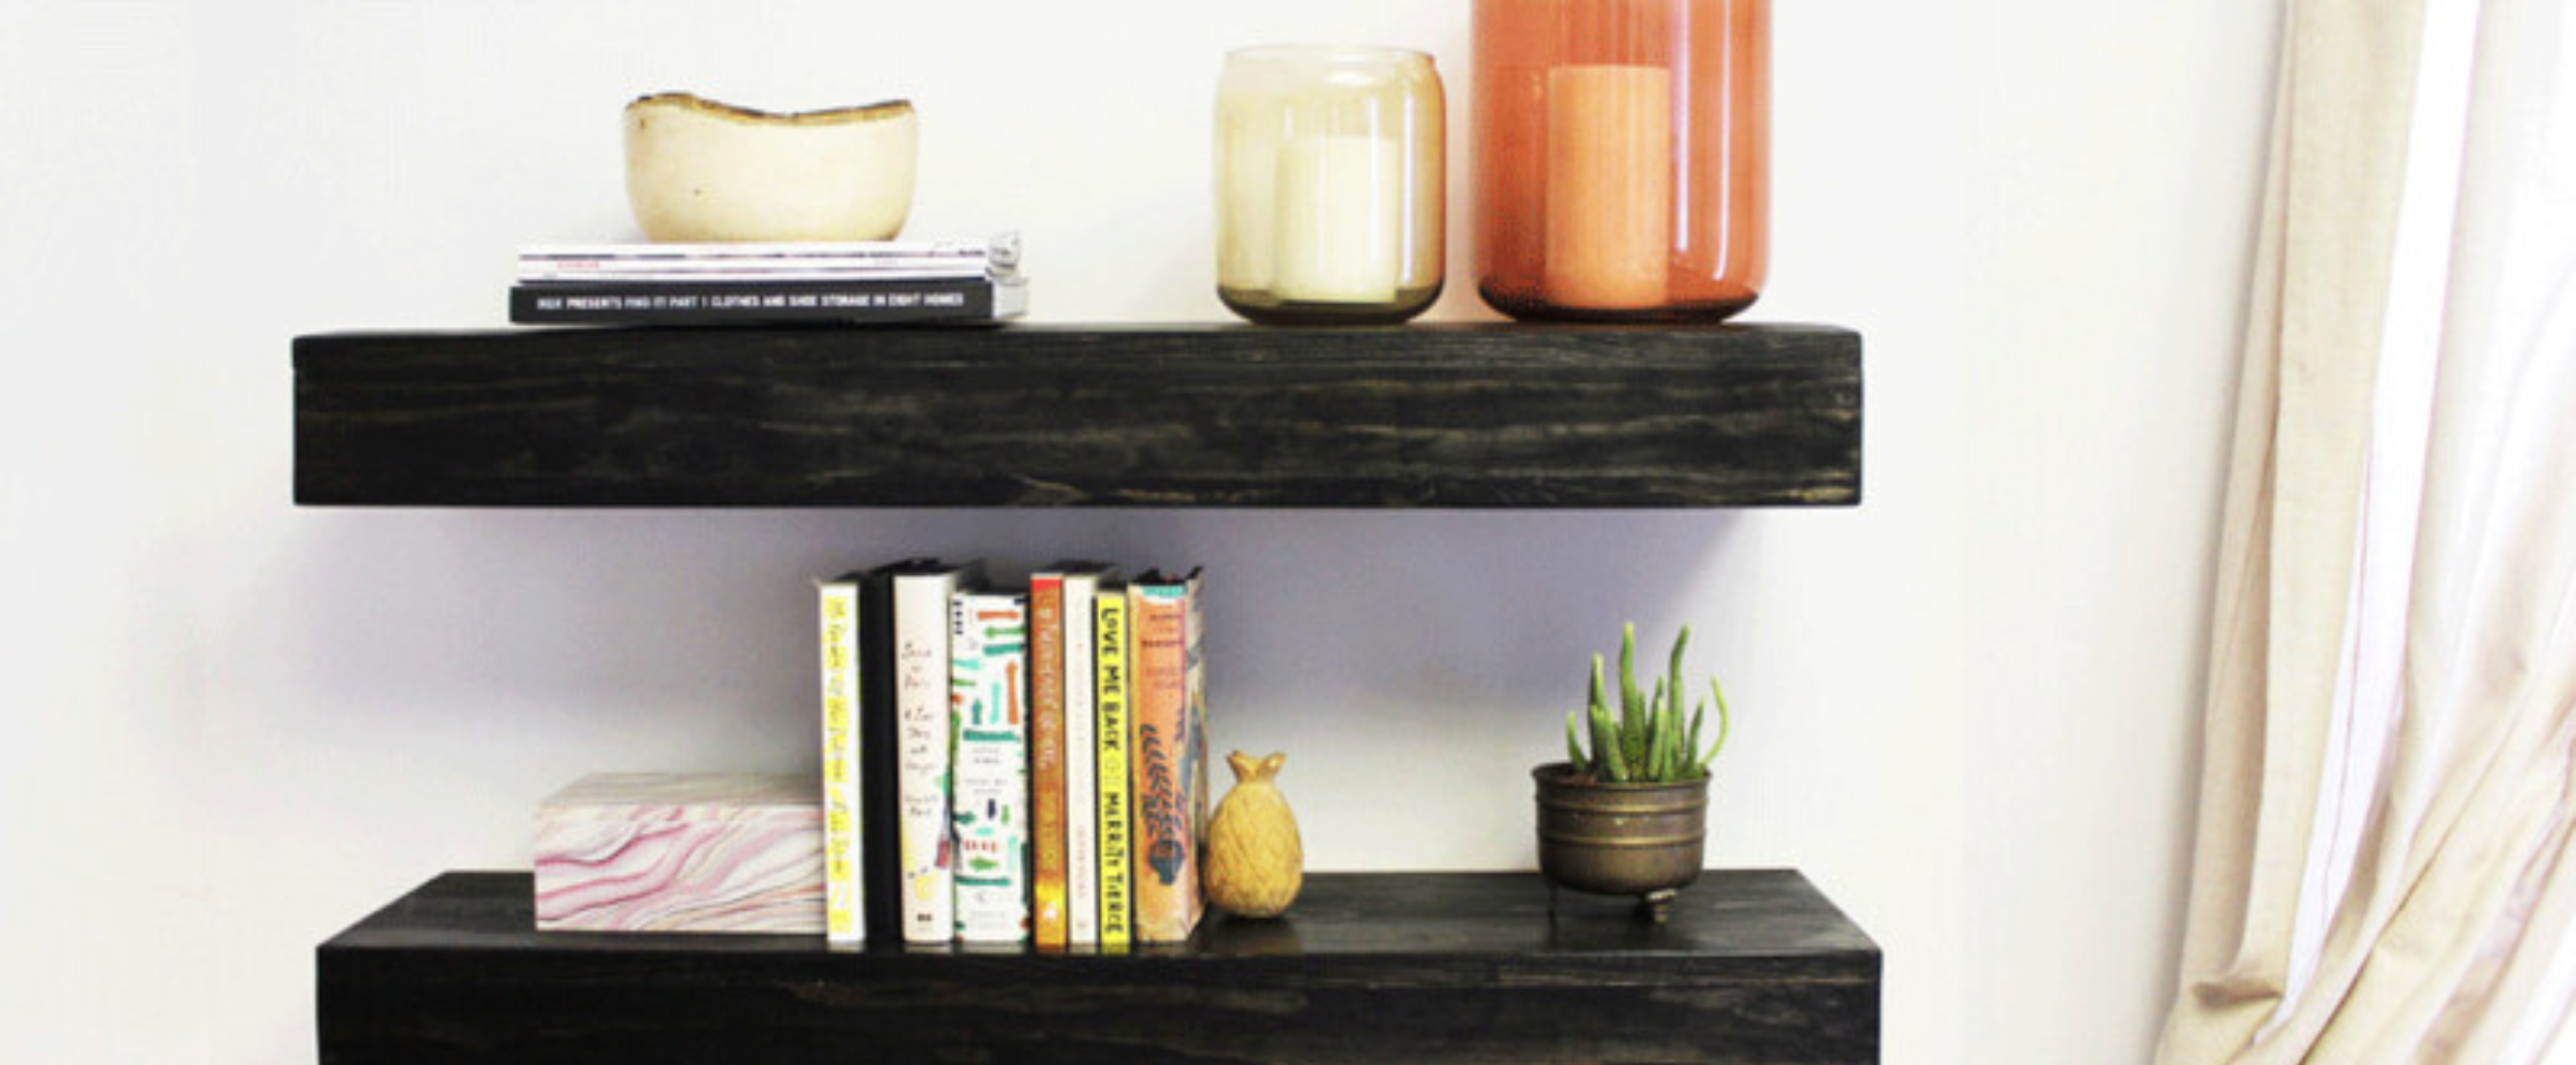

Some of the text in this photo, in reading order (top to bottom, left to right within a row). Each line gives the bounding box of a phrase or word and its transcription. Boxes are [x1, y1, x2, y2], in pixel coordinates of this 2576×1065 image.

[566, 297, 622, 310] PRESENTS
[669, 296, 696, 309] PART
[711, 295, 760, 309] CLOTHES
[762, 295, 785, 308] AND
[788, 295, 816, 307] SHOE
[820, 294, 870, 307] STORAGE
[873, 294, 886, 307] IN
[888, 293, 919, 307] EIGHT
[923, 292, 965, 307] HOMES
[1101, 607, 1121, 751] LOVE ME BACK
